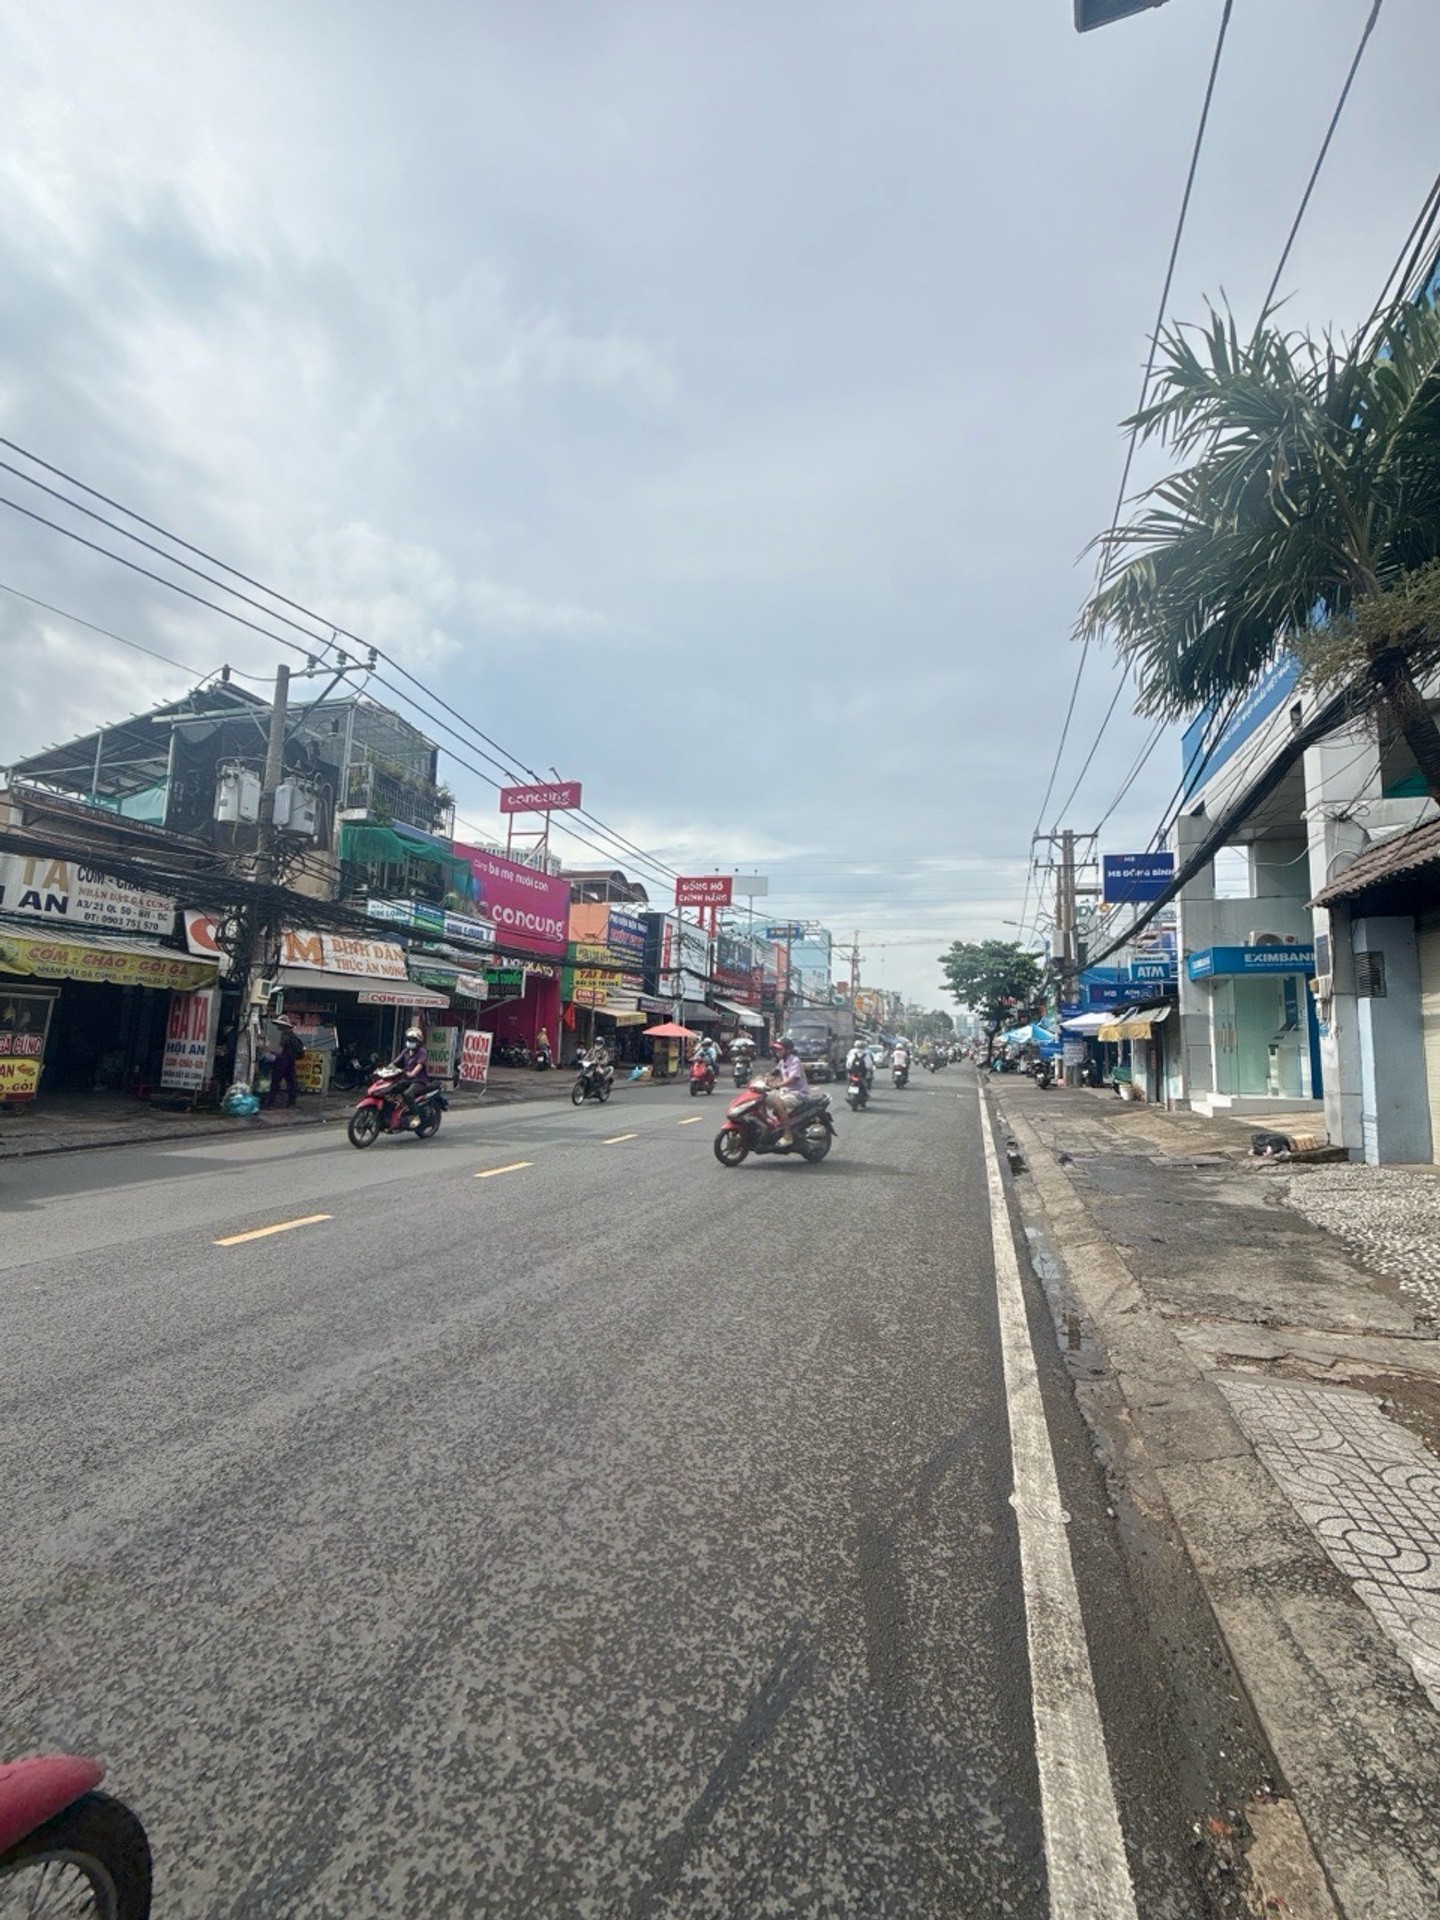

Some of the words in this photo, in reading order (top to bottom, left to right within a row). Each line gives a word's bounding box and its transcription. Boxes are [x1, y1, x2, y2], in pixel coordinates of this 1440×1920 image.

[488, 862, 499, 876] ba
[534, 881, 549, 892] con
[18, 890, 69, 914] AN
[1137, 966, 1165, 978] ATM
[188, 1042, 206, 1056] AN
[461, 1063, 486, 1080] 30K
